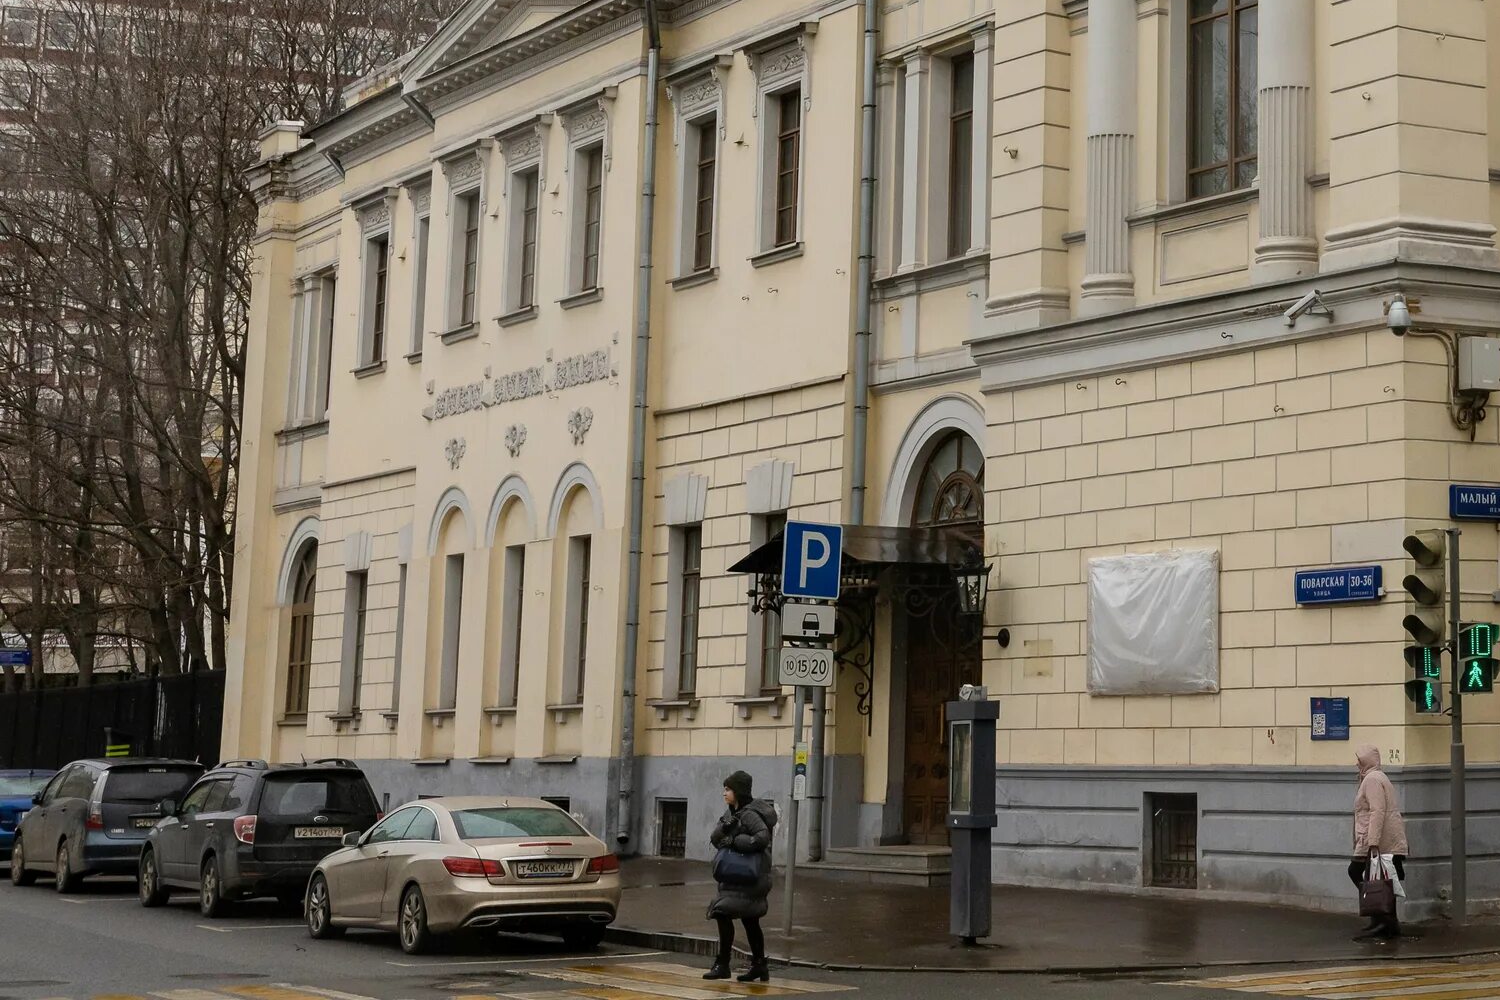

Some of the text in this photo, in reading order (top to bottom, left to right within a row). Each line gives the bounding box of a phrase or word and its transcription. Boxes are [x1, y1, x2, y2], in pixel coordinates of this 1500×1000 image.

[1460, 492, 1497, 504] МАЛЫЙ
[799, 531, 831, 588] P
[1301, 576, 1345, 589] ПОВАРСКАЯ
[1350, 575, 1372, 587] 30-36
[1471, 624, 1491, 656] 10
[786, 659, 827, 675] 10 15 20
